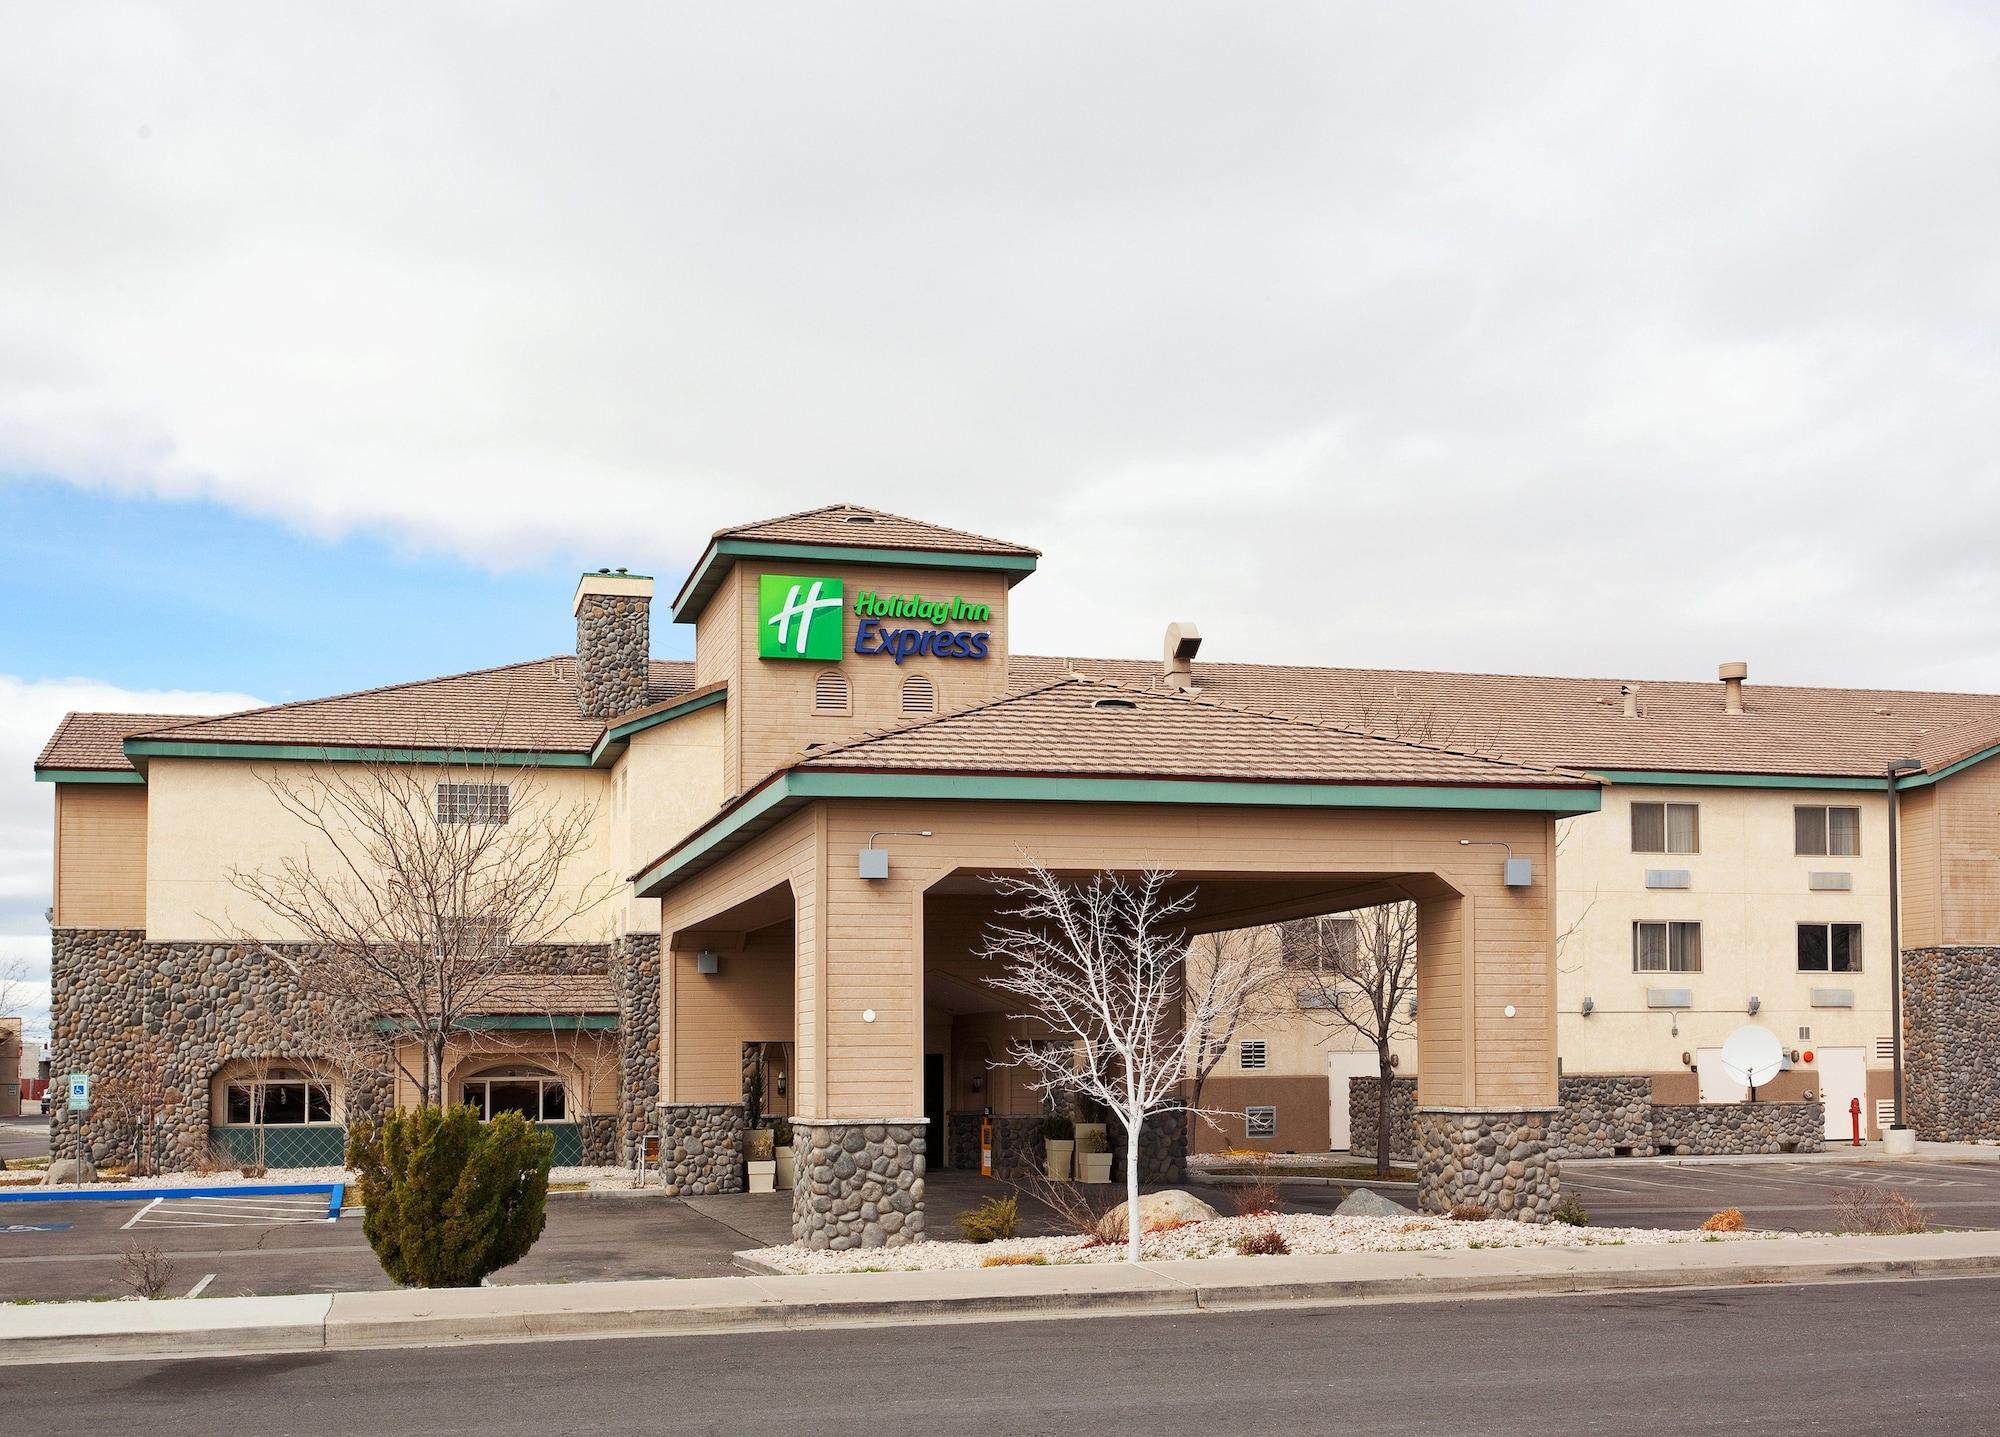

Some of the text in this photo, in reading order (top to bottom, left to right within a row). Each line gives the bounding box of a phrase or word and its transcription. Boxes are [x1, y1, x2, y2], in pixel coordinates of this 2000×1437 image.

[854, 591, 990, 625] Holiday Inn
[855, 618, 991, 665] Express
